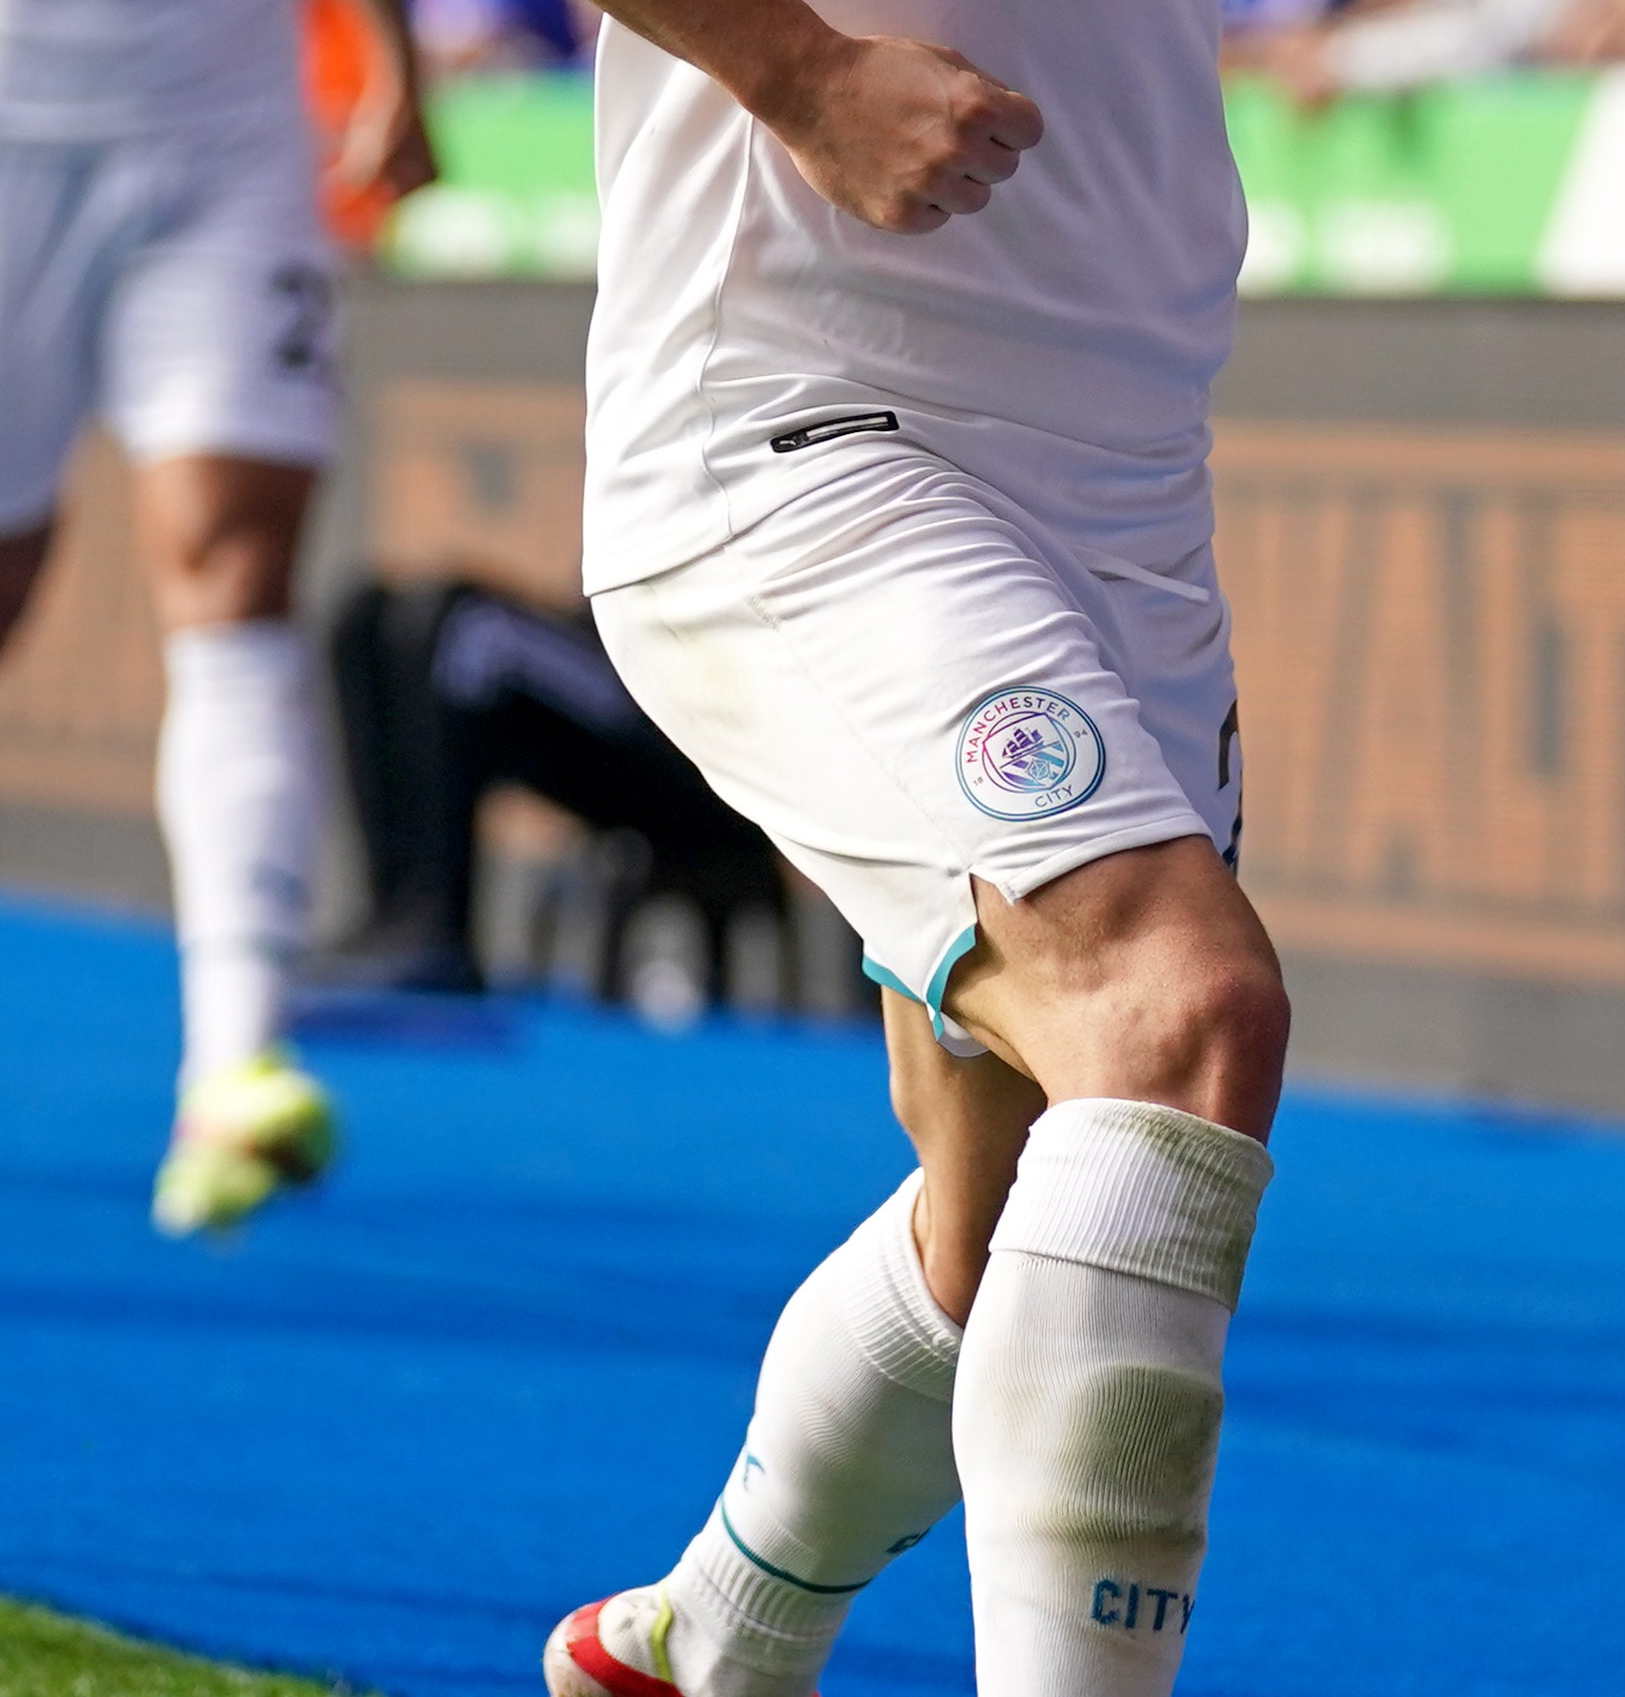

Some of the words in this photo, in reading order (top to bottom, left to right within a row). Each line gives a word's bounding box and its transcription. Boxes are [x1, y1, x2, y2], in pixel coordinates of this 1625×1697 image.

[966, 696, 1071, 763] MANCHESTER
[1035, 784, 1074, 808] CITY
[1090, 1578, 1196, 1634] CITY
